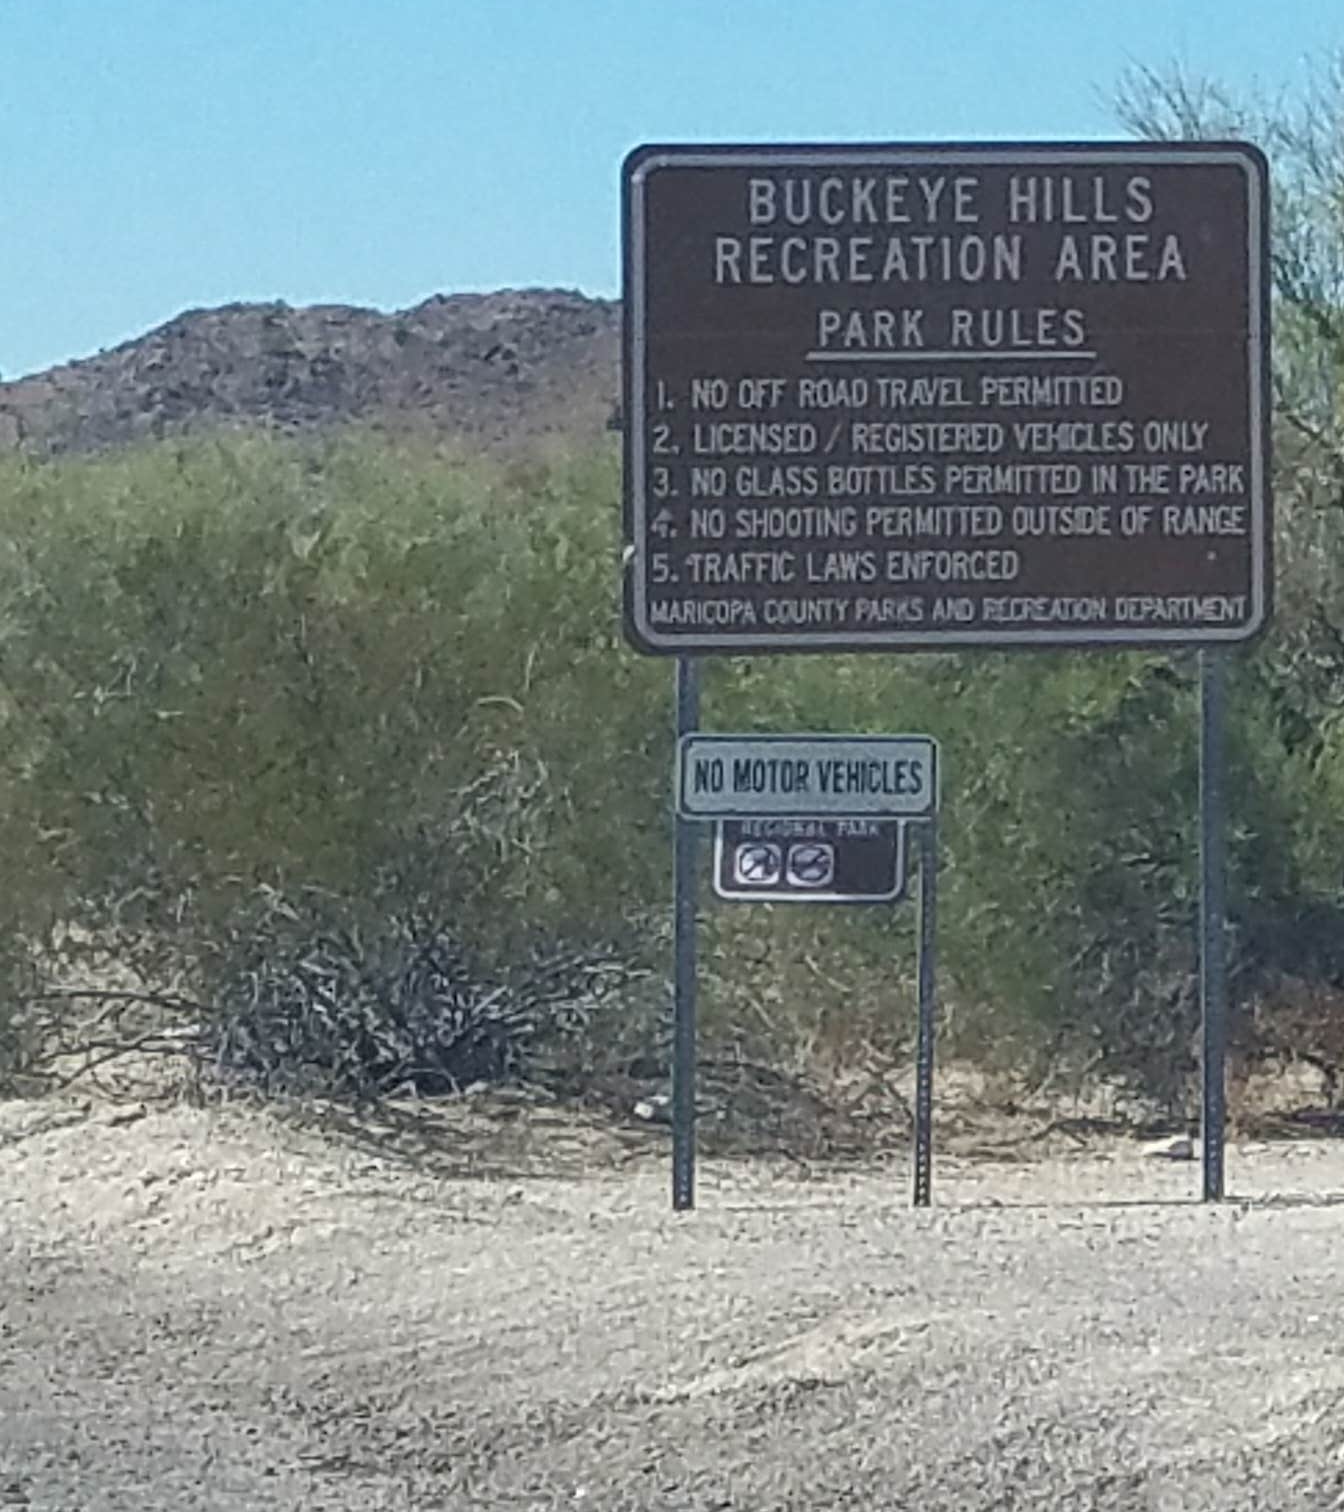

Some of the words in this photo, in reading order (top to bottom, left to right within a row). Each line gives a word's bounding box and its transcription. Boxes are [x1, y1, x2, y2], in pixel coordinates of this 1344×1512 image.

[749, 178, 979, 224] BUCKEYE
[1009, 177, 1153, 223] HILLS
[715, 236, 1021, 284] RECREATION
[1055, 234, 1187, 281] AREA
[819, 310, 924, 347] PARK
[951, 309, 1085, 346] RULES
[658, 380, 674, 409] 1.
[692, 379, 728, 409] NO
[739, 379, 787, 408] OFF
[800, 379, 867, 408] ROAD
[877, 378, 973, 407] TRAVEL
[980, 376, 1122, 405] PERMITTED
[652, 425, 680, 454] 2.
[694, 424, 817, 453] LICENSED
[824, 424, 841, 453] /
[852, 423, 1003, 452] REGISTERED
[1014, 422, 1134, 452] VEHICLES
[1144, 421, 1209, 452] ONLY
[652, 468, 678, 497] 3.
[691, 467, 726, 497] NO
[735, 467, 818, 496] GLASS
[827, 467, 936, 494] BOTTLES
[945, 465, 1081, 494] PERMITTED
[1092, 464, 1116, 493] IN
[1125, 464, 1169, 493] THE
[1179, 464, 1244, 494] PARK
[651, 508, 677, 538] 4.
[690, 508, 725, 538] NO
[735, 507, 857, 538] SHOOTING
[866, 506, 1003, 536] PERMITTED
[1012, 506, 1112, 535] OUTSIDE
[1121, 506, 1154, 535] OF
[1163, 505, 1246, 535] RANGE
[652, 553, 679, 582] 5.
[685, 551, 796, 582] TRAFFIC
[807, 551, 877, 581] LAWS
[887, 550, 1019, 580] ENFORCED
[650, 598, 756, 624] MARICOPA
[763, 598, 850, 624] COUNTY
[855, 597, 923, 621] PARKS
[932, 597, 974, 621] AND
[982, 597, 1106, 621] RECREATION
[1115, 596, 1246, 621] DEPARTMENT
[694, 759, 724, 794] NO
[733, 758, 810, 793] MOTOR
[816, 760, 923, 794] VEHICLES
